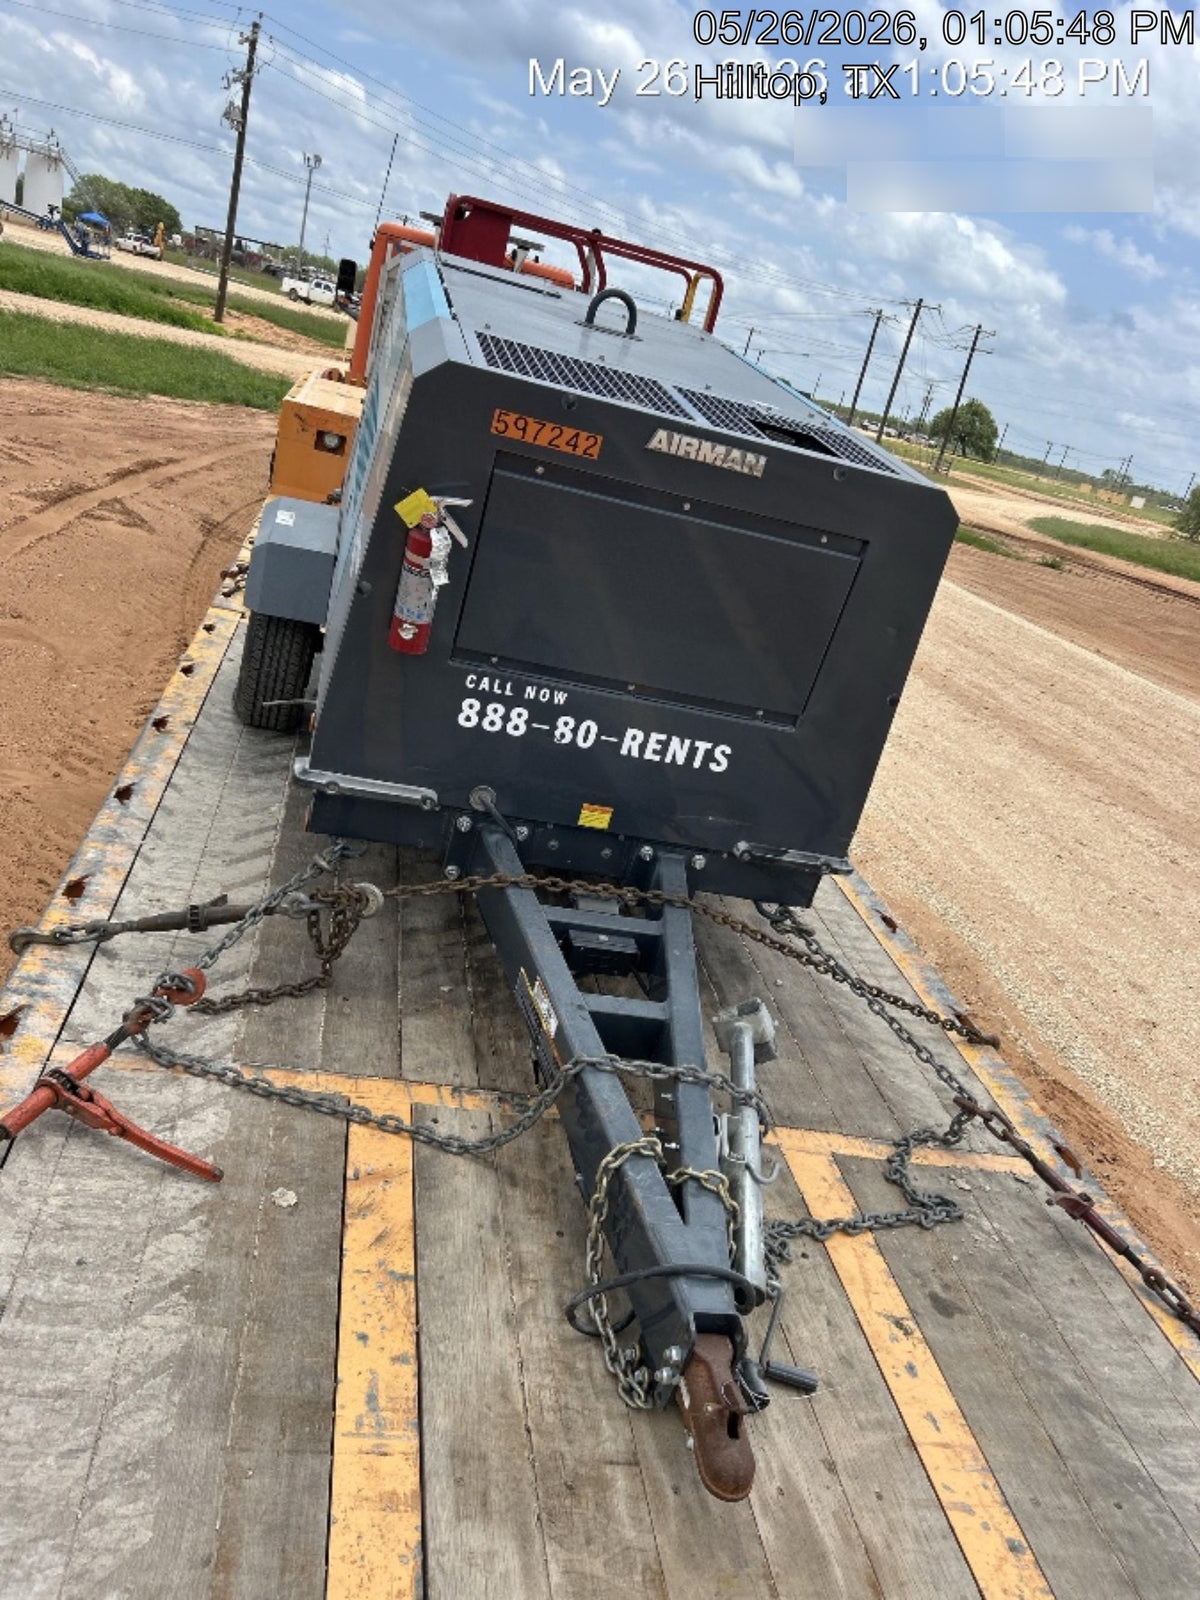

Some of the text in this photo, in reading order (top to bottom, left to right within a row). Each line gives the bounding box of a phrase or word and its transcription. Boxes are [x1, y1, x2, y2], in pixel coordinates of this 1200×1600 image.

[494, 411, 598, 458] 597242
[646, 428, 767, 478] AIRMAN
[465, 674, 568, 705] CALL NOW
[457, 698, 732, 772] 888-80-RENTS
